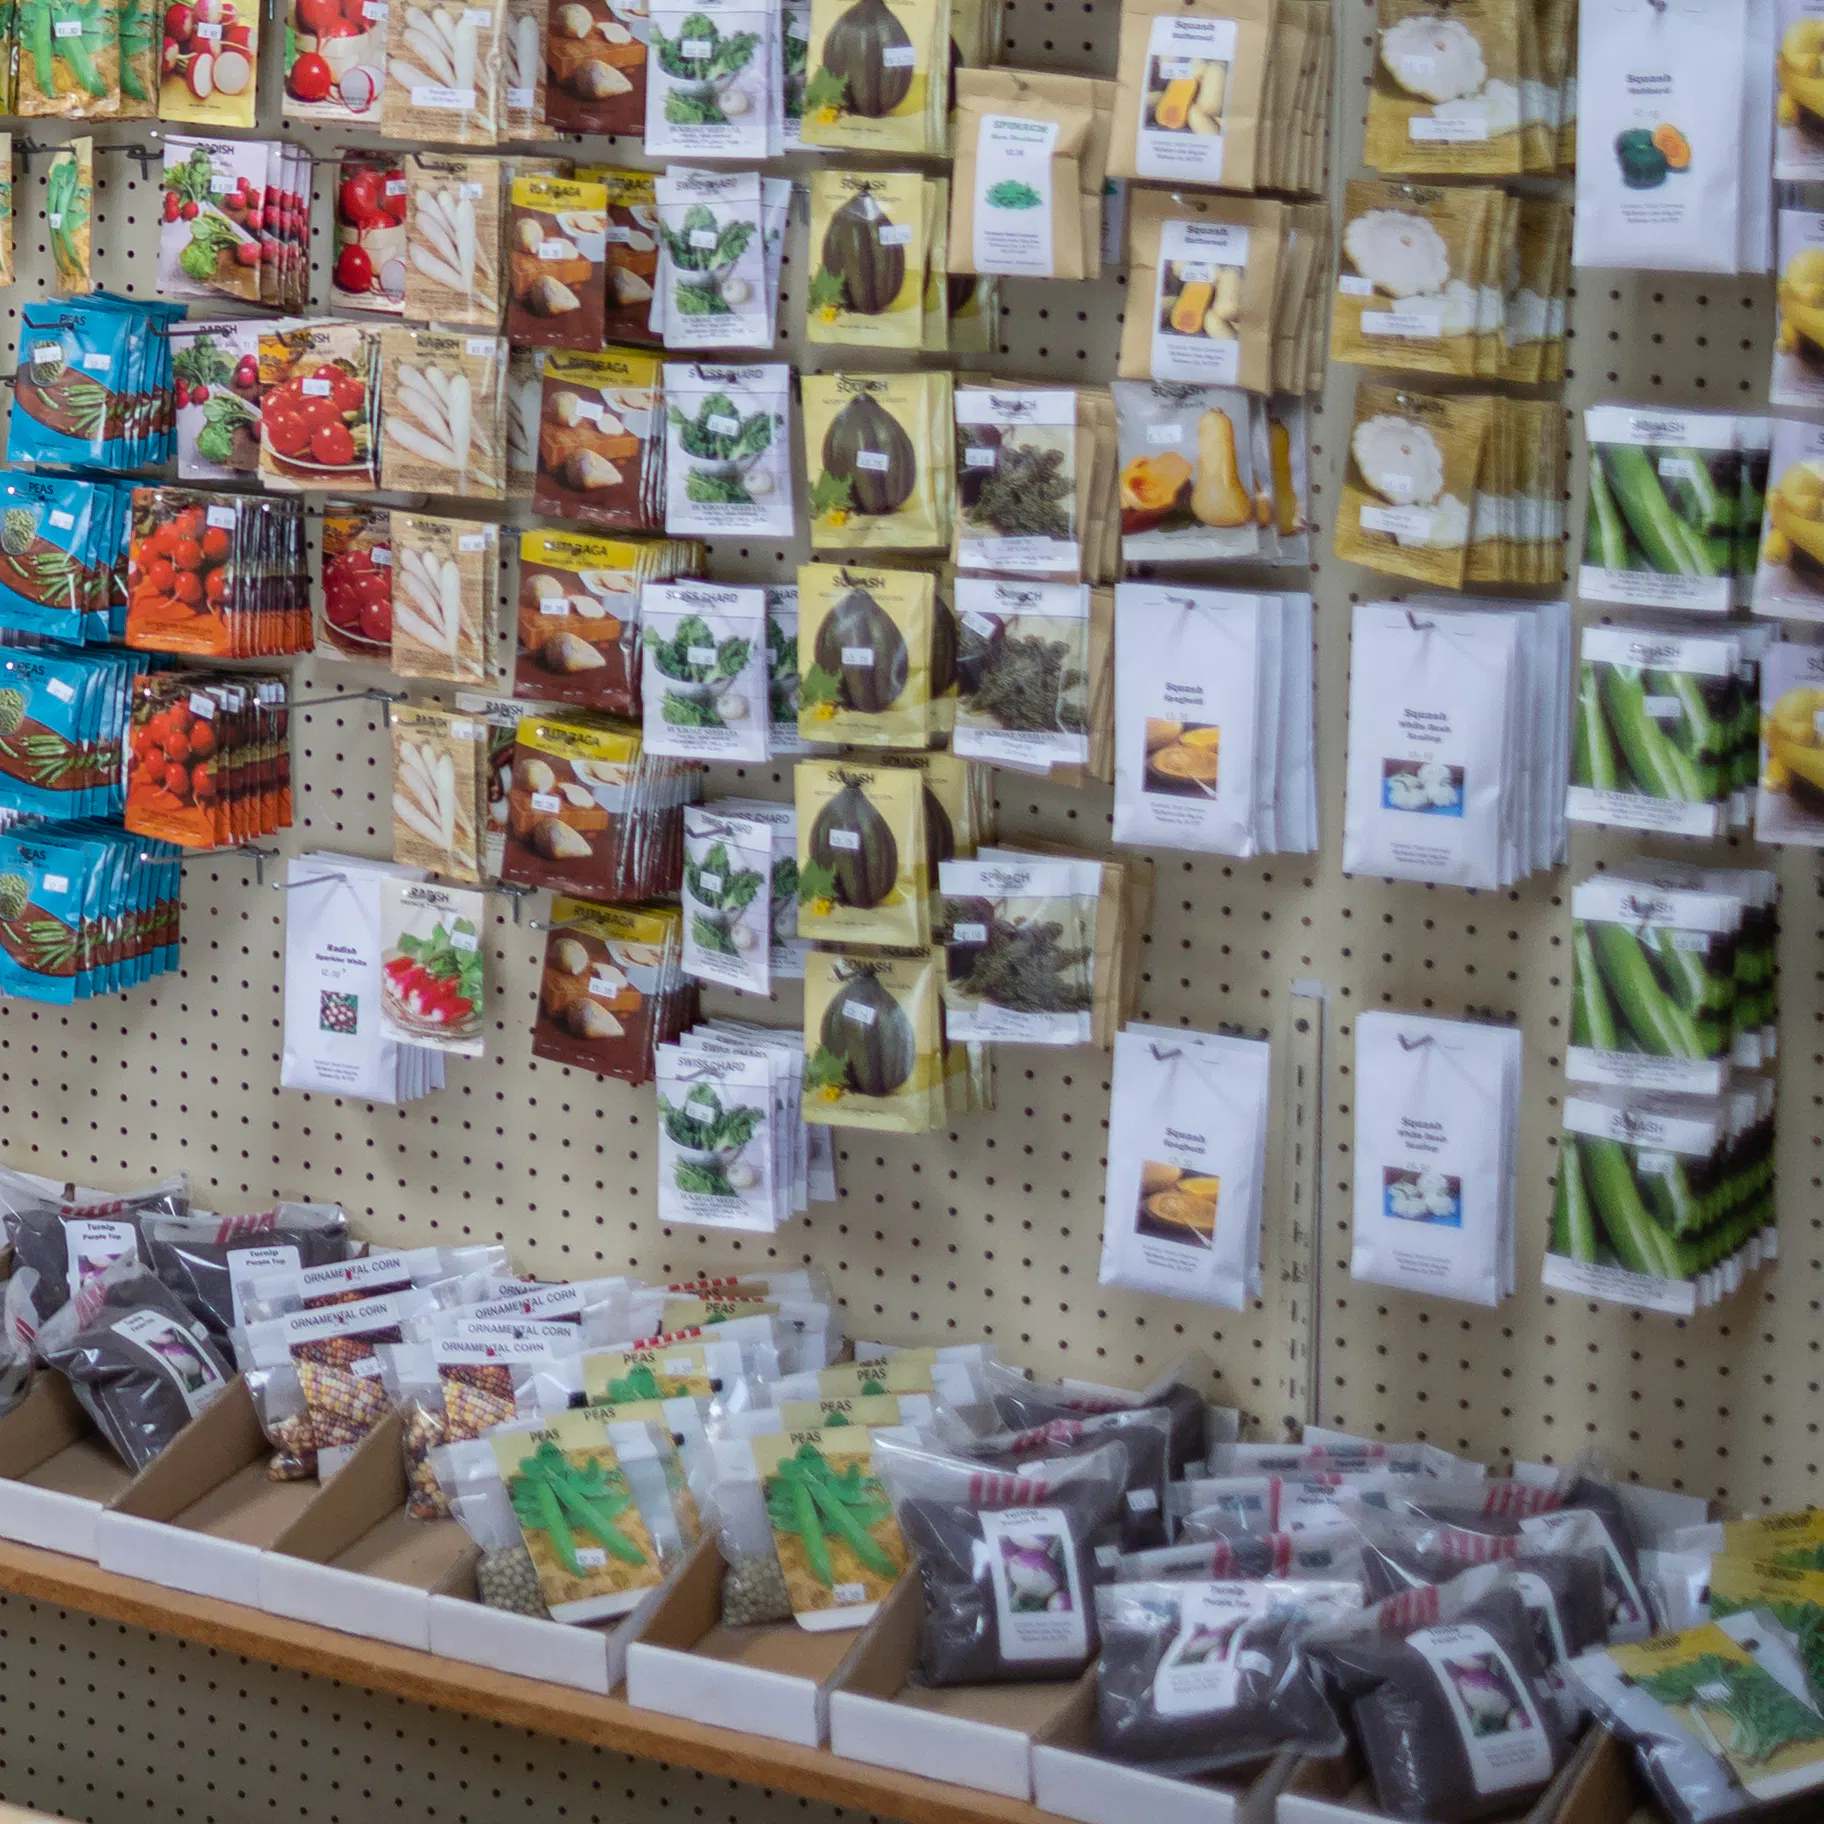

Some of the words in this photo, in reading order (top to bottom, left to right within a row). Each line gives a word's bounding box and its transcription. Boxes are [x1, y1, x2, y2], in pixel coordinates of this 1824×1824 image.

[1173, 21, 1218, 34] Squash
[1626, 74, 1673, 87] Squash
[1185, 225, 1230, 237] Squash
[1164, 681, 1206, 695] Squash
[1403, 707, 1448, 723] Squash
[326, 943, 358, 955] Radish
[711, 1059, 746, 1073] CHARD
[1400, 1116, 1444, 1132] Squash
[1164, 1126, 1207, 1145] Squash
[371, 1257, 400, 1272] CORN
[546, 1288, 577, 1304] CORN
[359, 1303, 388, 1317] CORN
[705, 1303, 736, 1315] PEAS
[541, 1326, 572, 1337] CORN
[513, 1342, 545, 1353] CORN
[623, 1352, 657, 1364] PEAS
[857, 1369, 887, 1381] PEAS
[820, 1400, 852, 1413] PEAS
[583, 1407, 616, 1420] PEAS
[530, 1429, 561, 1442] PEAS
[789, 1431, 822, 1444] PEAS
